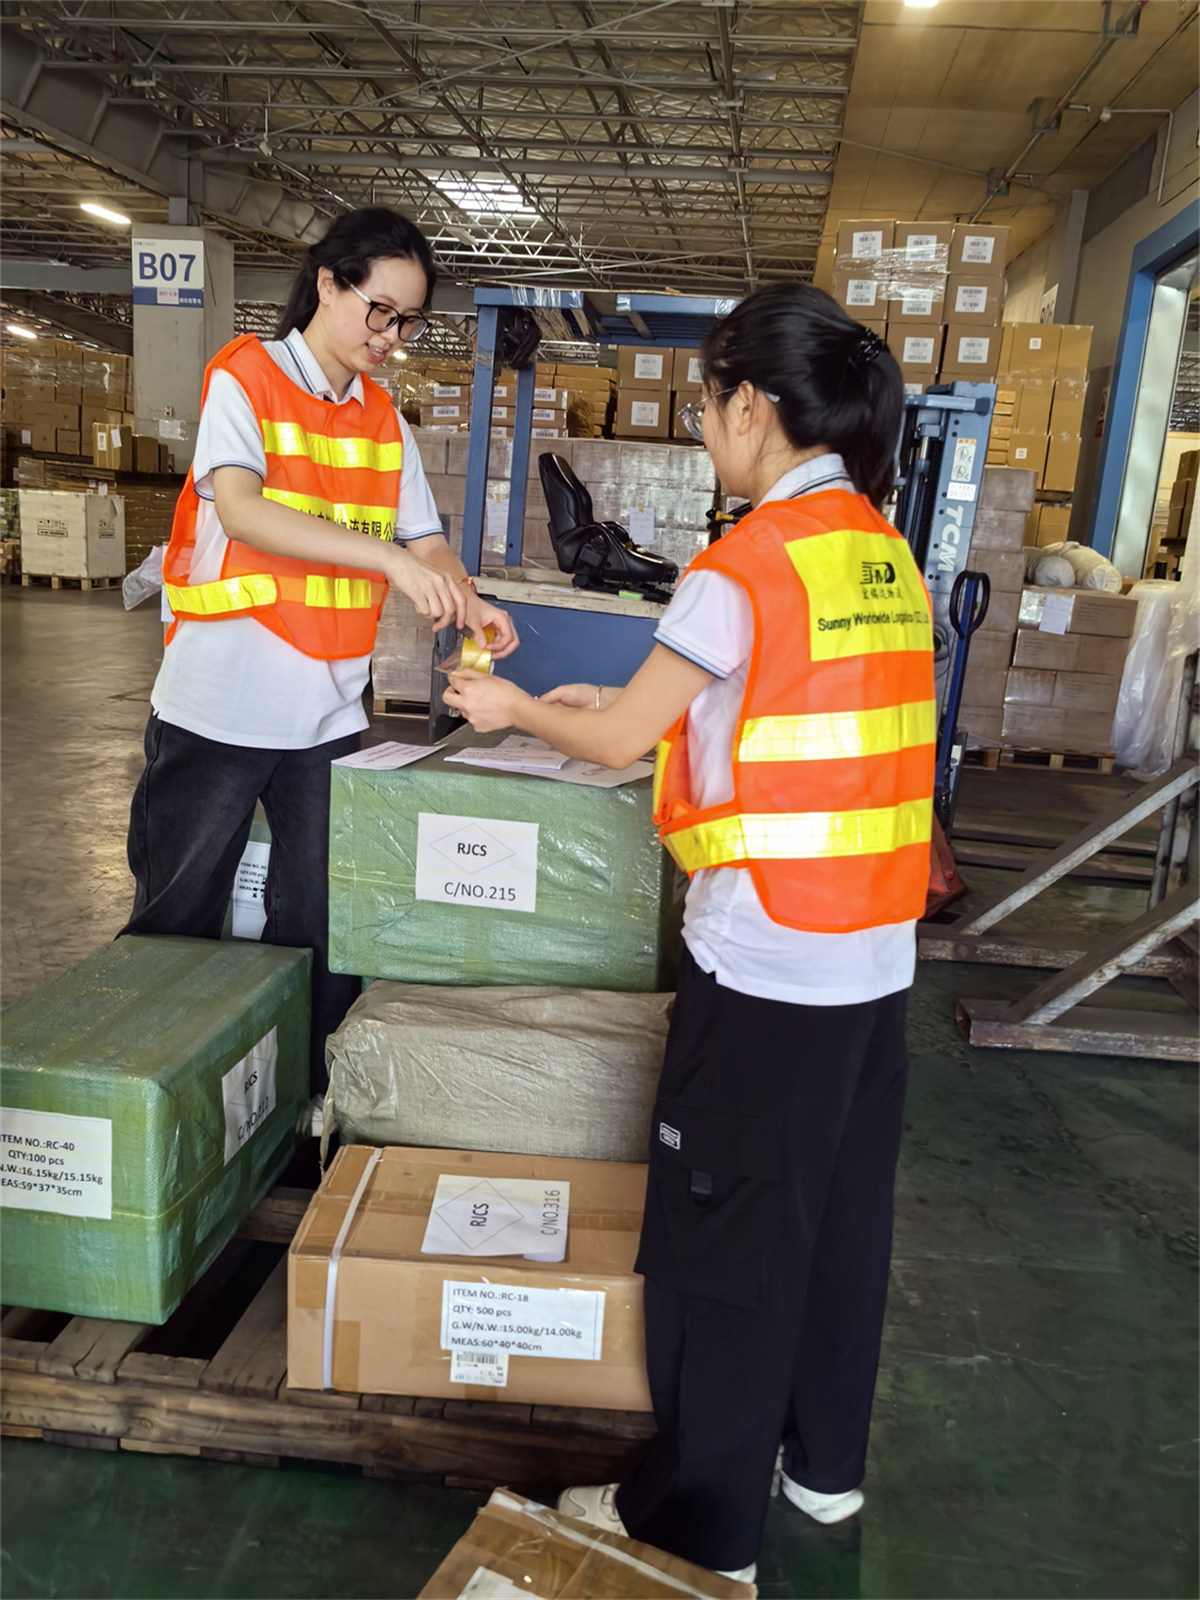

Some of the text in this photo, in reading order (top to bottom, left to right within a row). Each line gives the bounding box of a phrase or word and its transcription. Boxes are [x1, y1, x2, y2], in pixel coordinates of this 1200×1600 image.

[139, 252, 196, 282] B07
[937, 505, 964, 573] TCM
[817, 617, 851, 632] Sunny
[457, 842, 487, 857] RJCS
[444, 881, 516, 901] C/NO.215
[25, 1138, 75, 1151] NO.:RC-40
[8, 1149, 65, 1166] QTY:100 pcs
[0, 1164, 103, 1185] N.W.:16.15kg/15.15kg
[1, 1178, 82, 1196] EAS:593735cm
[470, 1202, 489, 1227] RJCS
[540, 1189, 560, 1236] C/NO.316
[452, 1288, 529, 1302] ITEM NO.:RC-18
[452, 1304, 512, 1318] QTY: 500 pcs
[451, 1320, 582, 1339] G.W/N.W.:15.00kg/14.00kg
